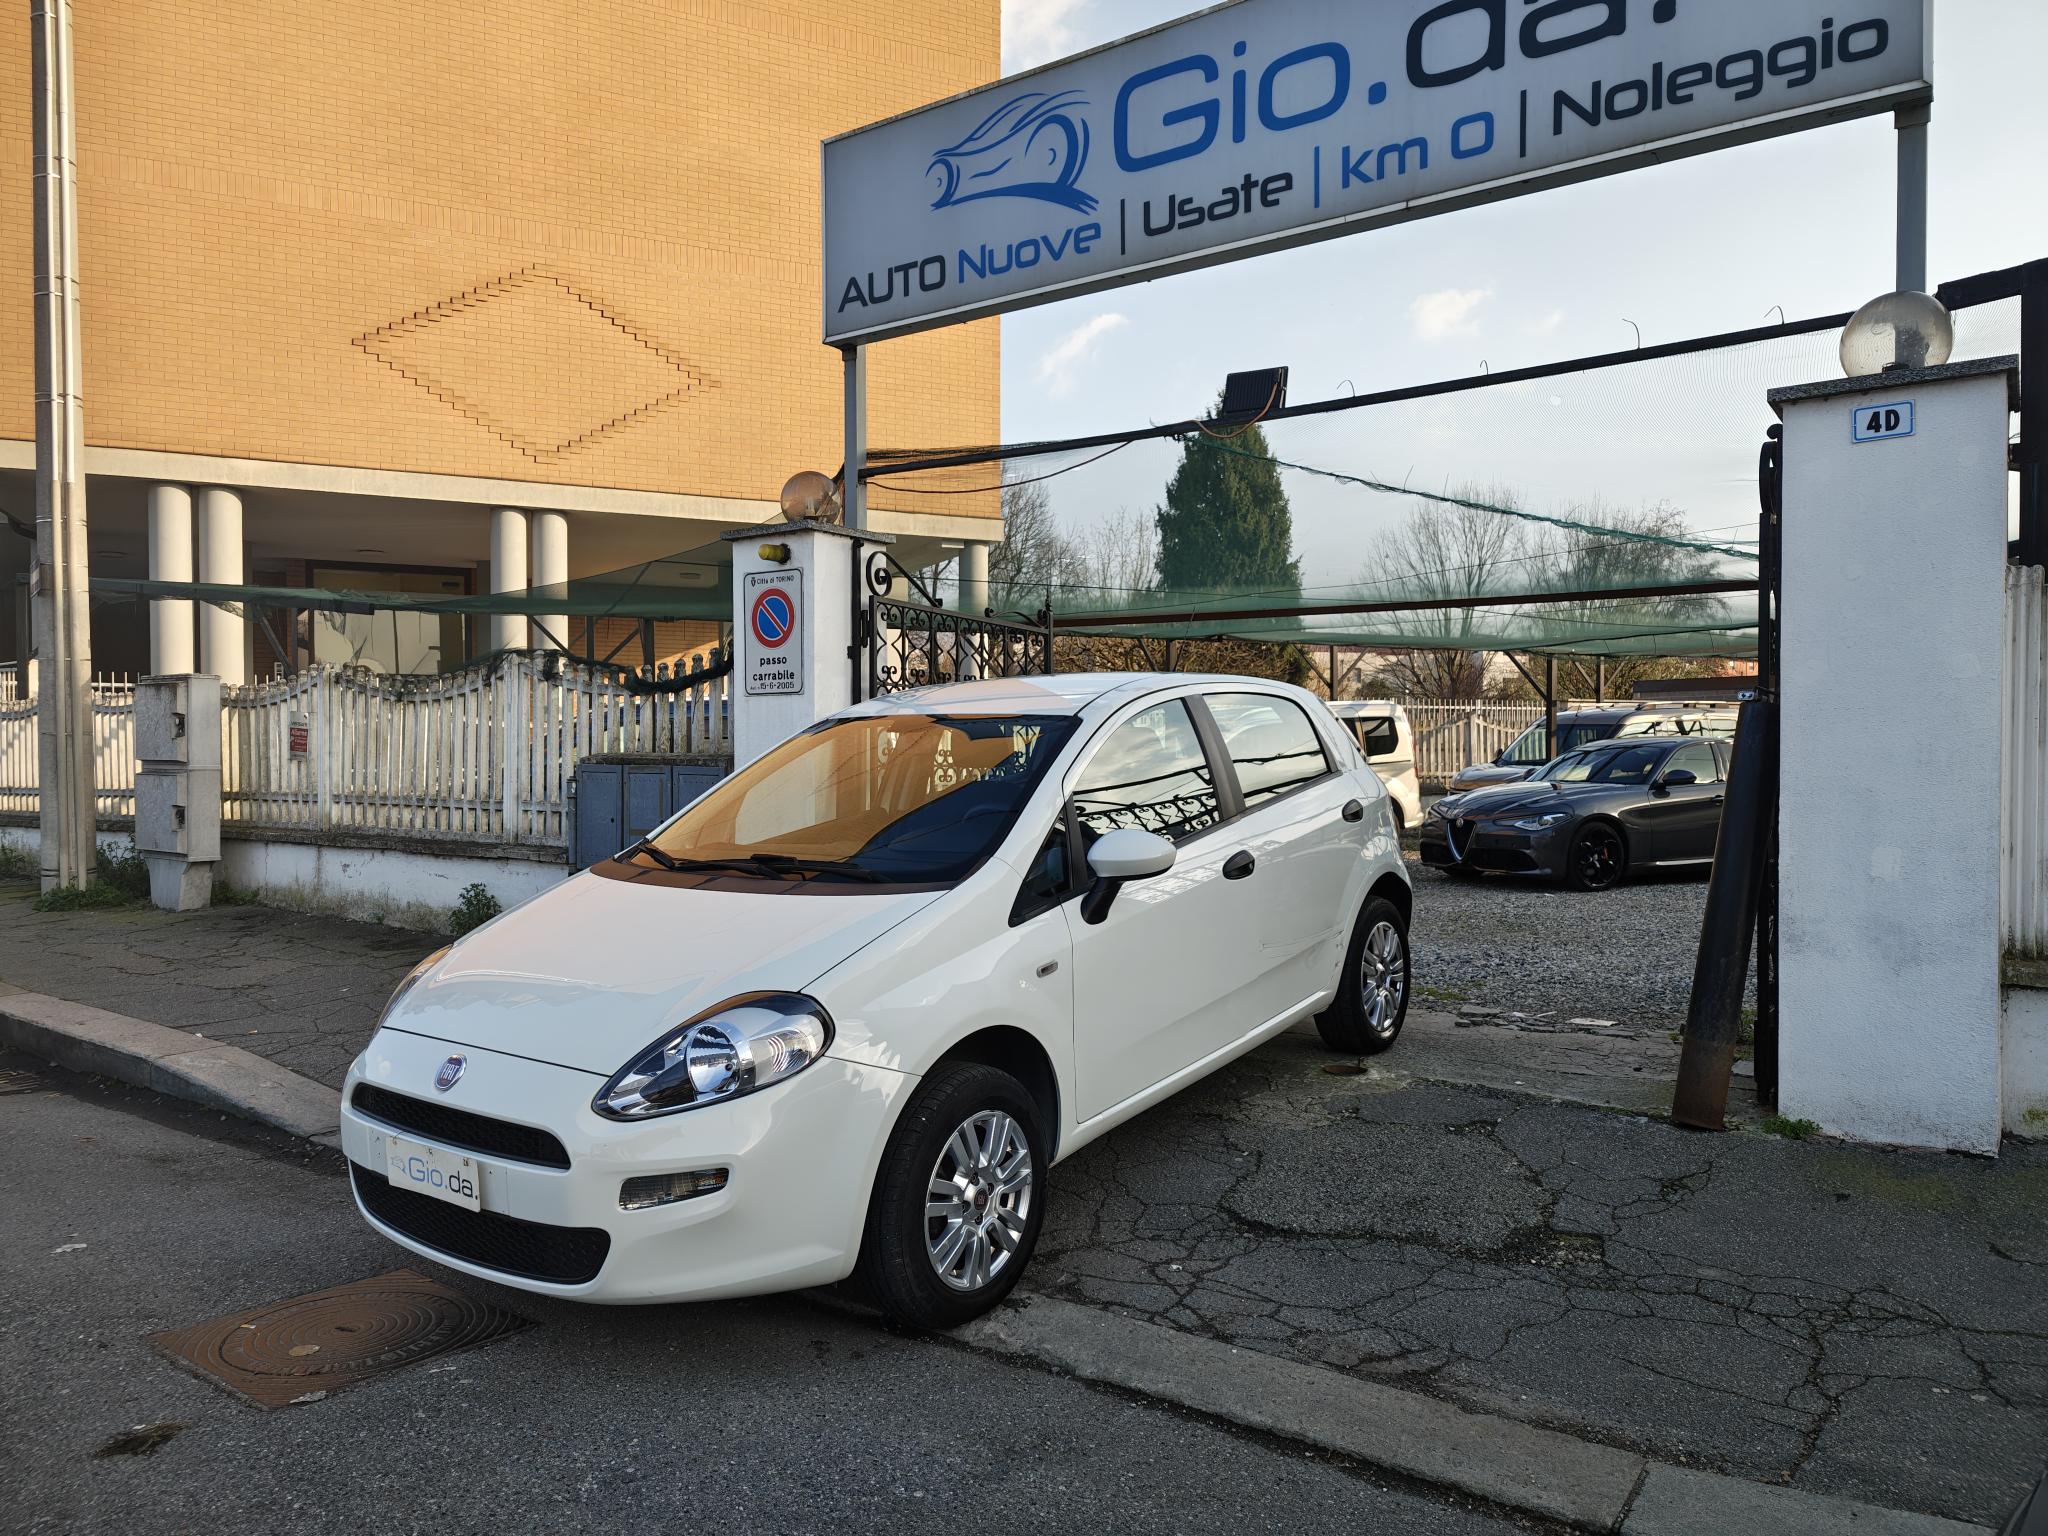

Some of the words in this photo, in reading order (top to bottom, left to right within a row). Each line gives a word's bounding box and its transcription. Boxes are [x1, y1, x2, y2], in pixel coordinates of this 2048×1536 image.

[837, 255, 947, 313] AUTO
[957, 221, 1101, 285] Nuove
[1143, 171, 1294, 237] Usate
[1341, 135, 1429, 189] km
[1552, 17, 1890, 136] Noleggio
[1866, 409, 1900, 433] 4D
[776, 574, 795, 583] TORINO
[759, 656, 788, 668] passo
[752, 669, 795, 681] carrabile
[440, 1063, 461, 1081] FIAT
[408, 1156, 478, 1201] Gio.da.
